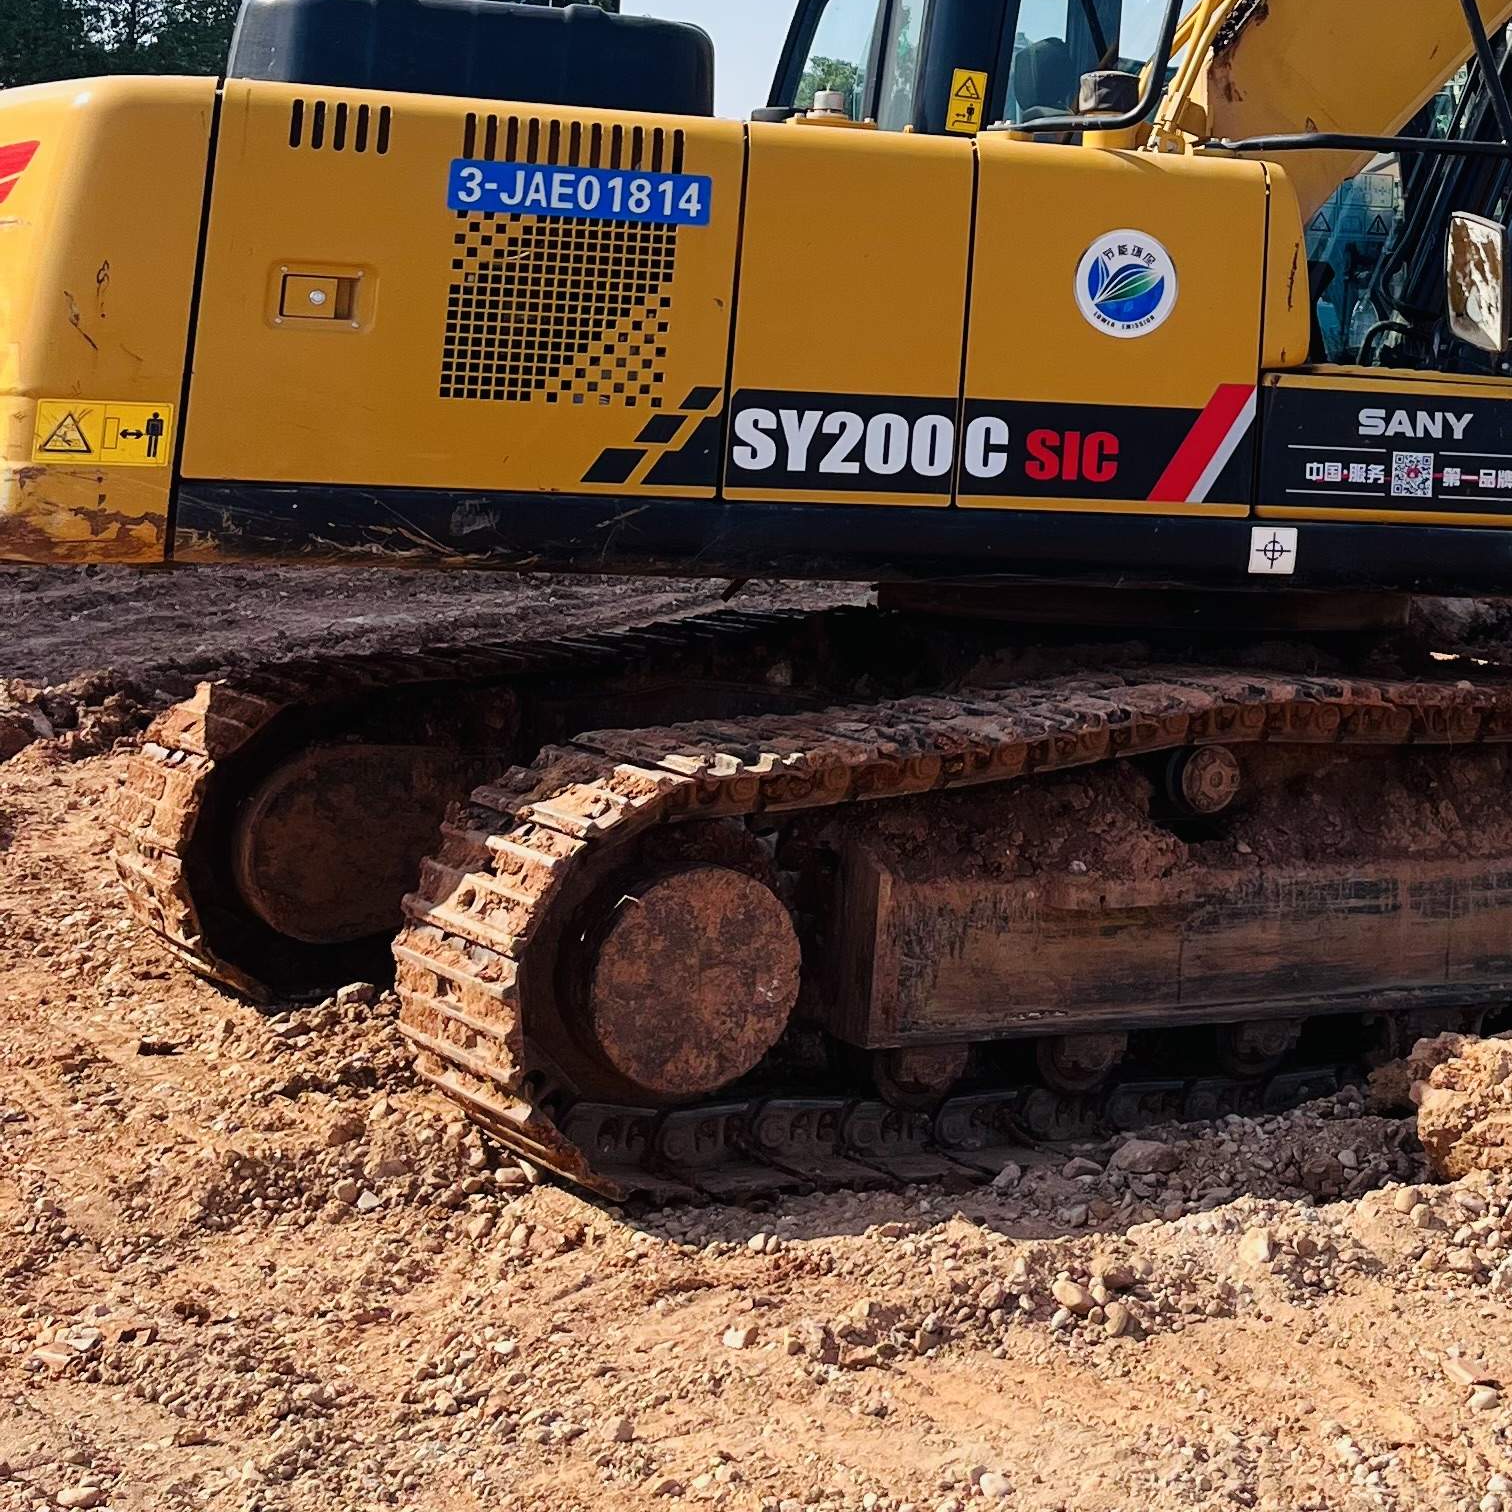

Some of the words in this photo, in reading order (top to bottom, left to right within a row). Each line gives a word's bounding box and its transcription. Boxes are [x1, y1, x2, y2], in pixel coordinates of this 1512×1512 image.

[458, 166, 702, 218] 3-JAE01814
[732, 407, 1009, 478] SY200C
[1025, 429, 1119, 482] SIC
[1358, 408, 1474, 440] SANY
